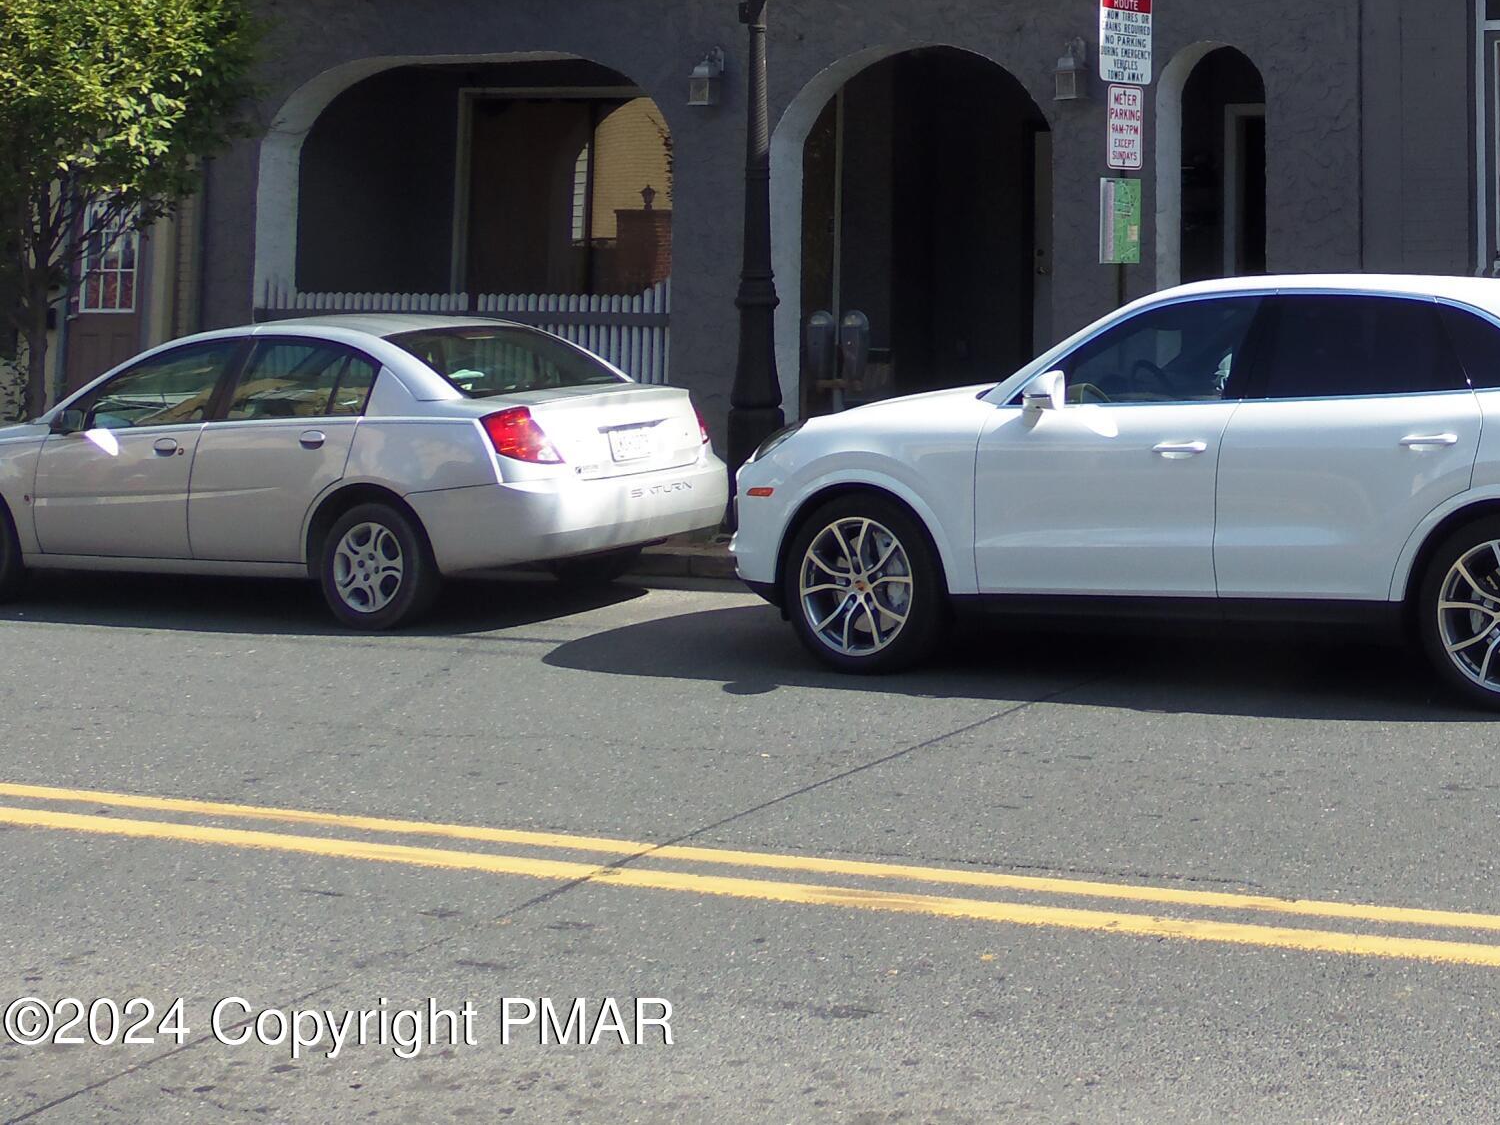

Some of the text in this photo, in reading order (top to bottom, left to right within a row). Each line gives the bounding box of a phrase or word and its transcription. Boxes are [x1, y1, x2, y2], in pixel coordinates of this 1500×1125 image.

[1122, 11, 1139, 23] TIRES
[1141, 14, 1150, 24] OR
[1123, 24, 1151, 36] REQUIRED
[1105, 34, 1147, 48] NO PARKING
[1101, 45, 1151, 60] DURING EMERGENCY
[1113, 58, 1138, 71] VEHICLES
[1107, 69, 1144, 83] TOWED AWAY
[1114, 93, 1137, 106] METER
[1110, 108, 1140, 121] PARKING
[1112, 124, 1139, 135] 9AM-7PM
[1114, 139, 1135, 148] EXCEPT
[1112, 151, 1137, 161] SUNDAYS
